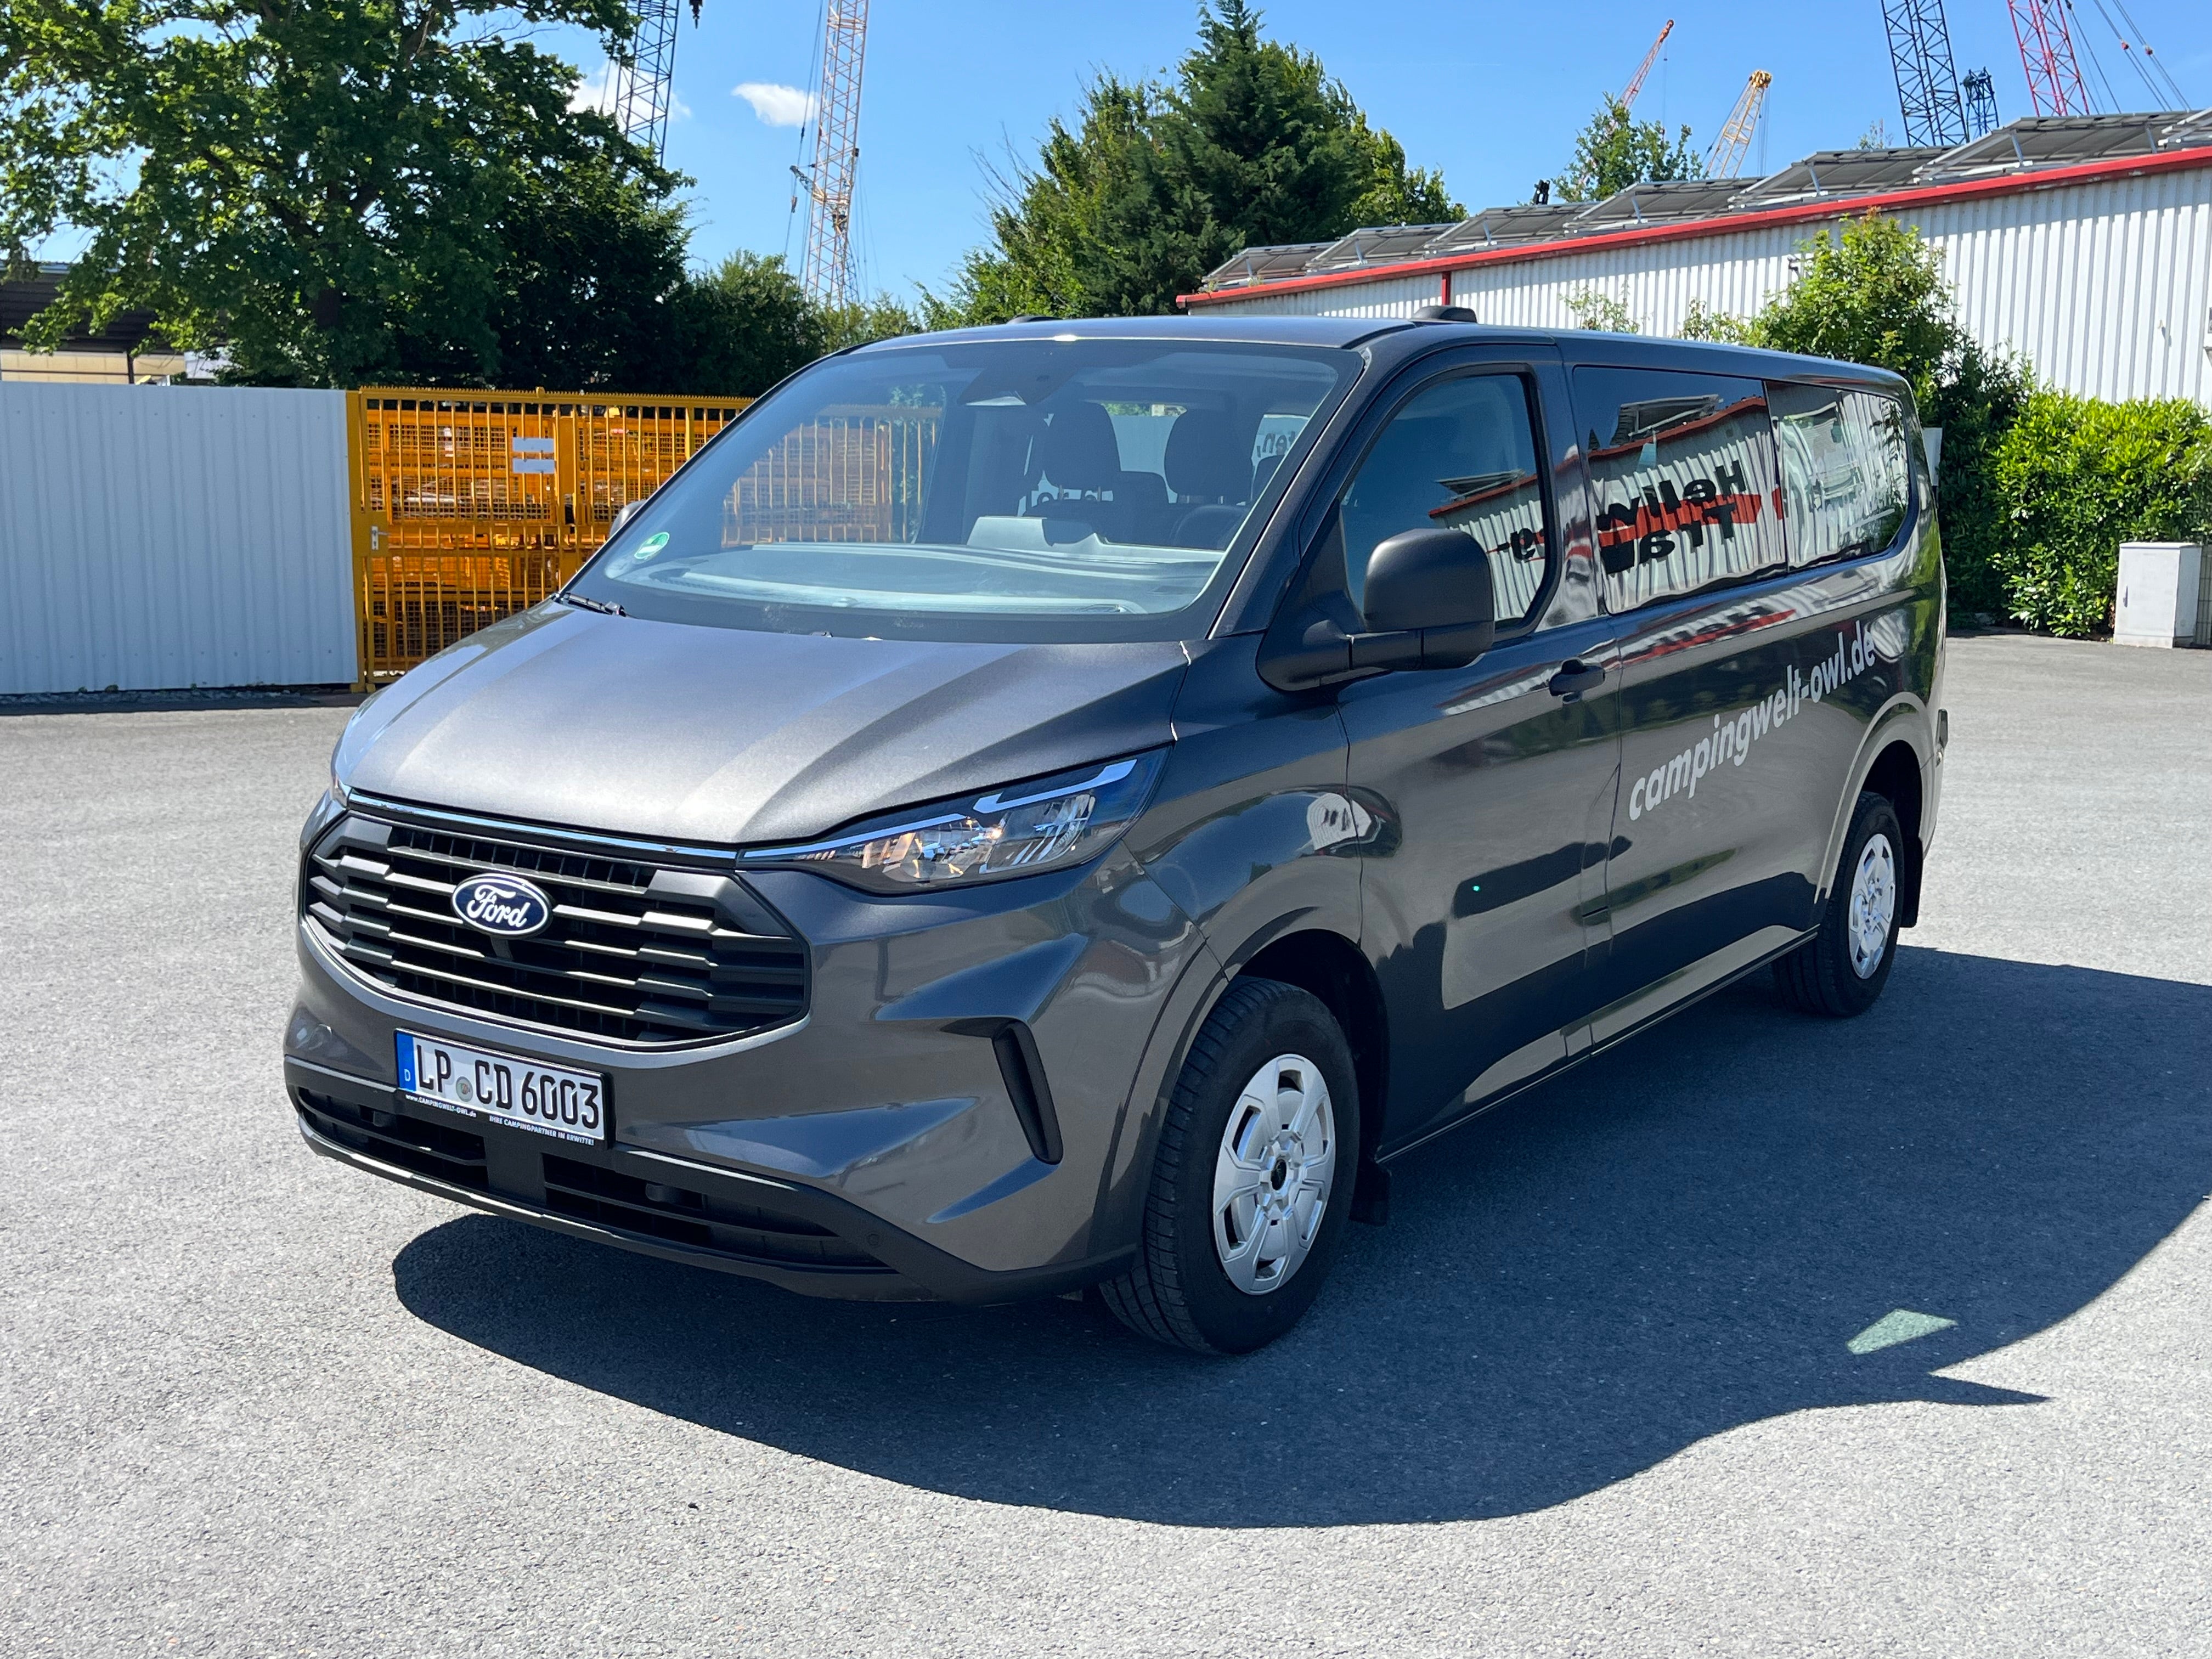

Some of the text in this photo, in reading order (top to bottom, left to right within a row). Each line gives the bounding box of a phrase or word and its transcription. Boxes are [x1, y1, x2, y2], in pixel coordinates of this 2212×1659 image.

[1629, 620, 1875, 821] campingwelt-owl.de
[467, 884, 531, 927] Ford
[404, 1045, 599, 1129] D LP CD 6003
[489, 1115, 503, 1124] IHRE
[504, 1119, 557, 1137] CAMPINGPARTNER
[558, 1131, 565, 1139] IN
